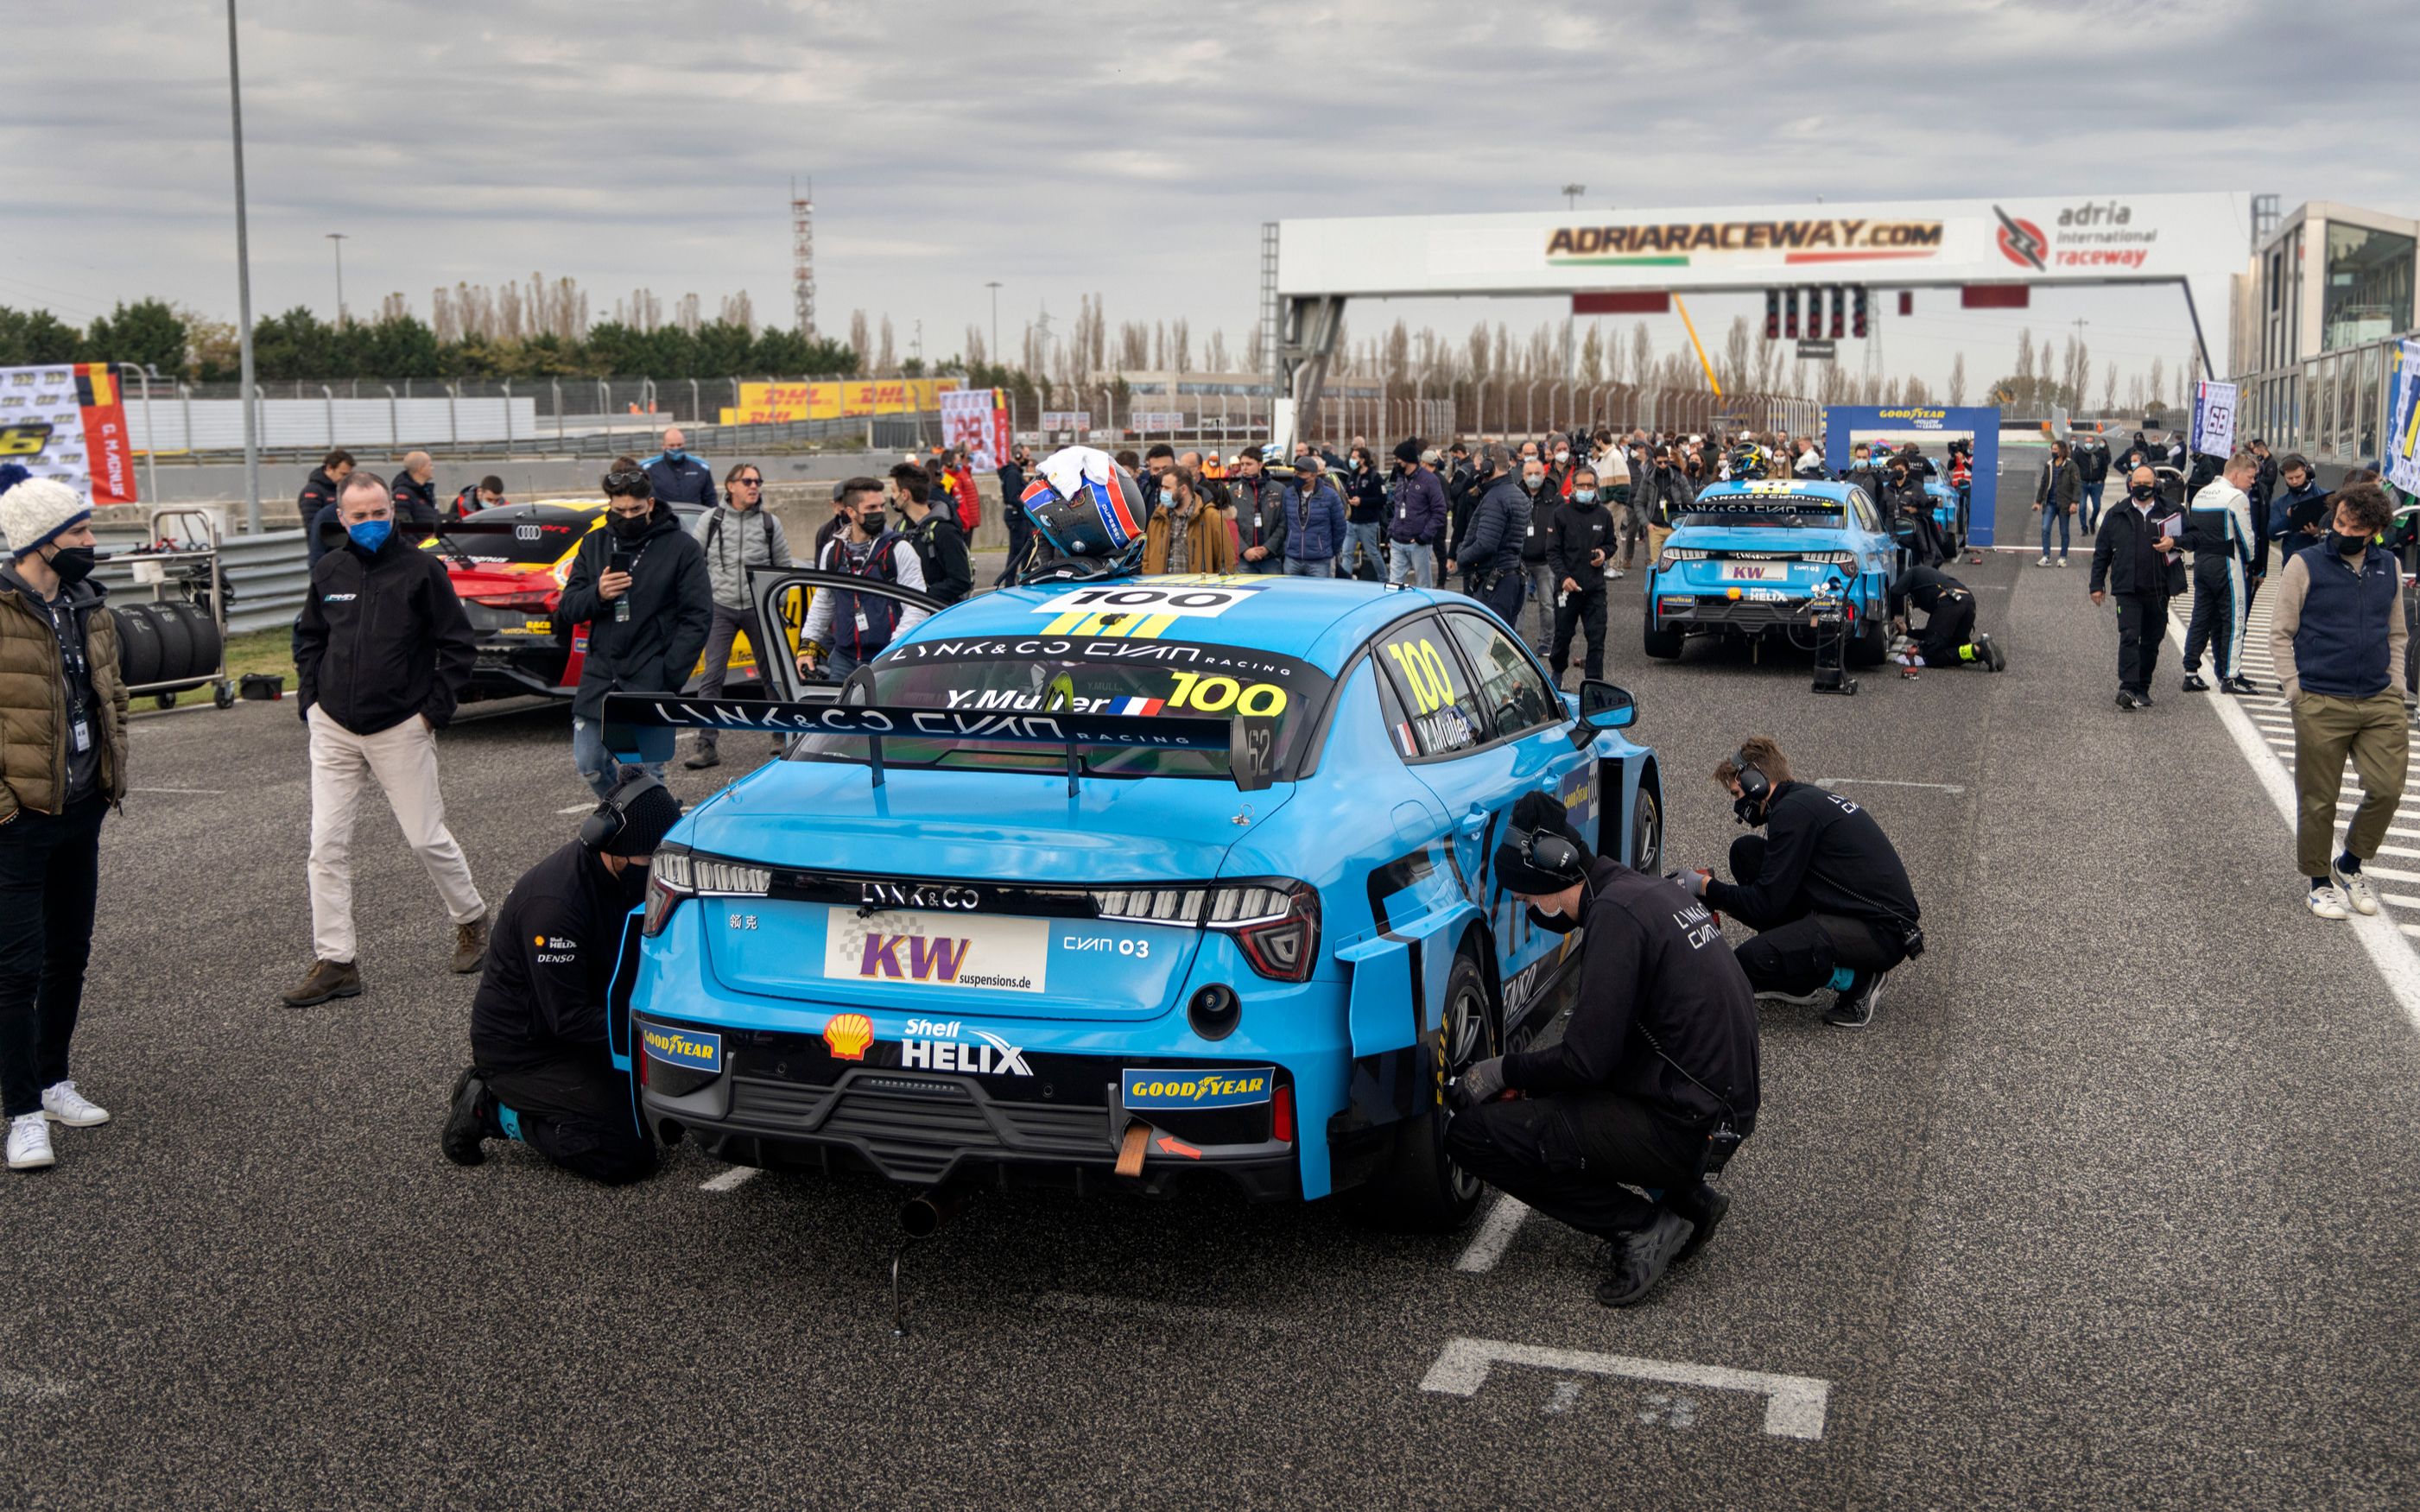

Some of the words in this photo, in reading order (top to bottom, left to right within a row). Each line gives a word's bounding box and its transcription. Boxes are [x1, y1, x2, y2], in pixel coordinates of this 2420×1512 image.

[2057, 201, 2132, 226] adria
[1547, 220, 1942, 256] ADRIARACEWAY.COM
[2056, 229, 2157, 244] international
[2056, 250, 2148, 269] raceway
[763, 388, 821, 405] DHL
[860, 386, 906, 404] DHL
[1879, 408, 1945, 420] GOODYEAR
[105, 440, 125, 497] MAGNUS
[1733, 566, 1765, 579] KW
[1070, 591, 1232, 608] 100
[1750, 590, 1788, 602] HELIX
[890, 641, 1070, 661] LYNK&CO
[1205, 657, 1290, 676] RACING
[1387, 638, 1454, 715] 100
[1166, 672, 1287, 718] 100
[656, 702, 894, 731] LYNK&CO
[1077, 732, 1189, 743] RACING
[1417, 712, 1471, 753] Y.Muller
[862, 883, 979, 909] LYNK&CO
[549, 939, 577, 949] HELIX
[1118, 939, 1150, 958] 03
[537, 954, 575, 963] DENSO
[858, 933, 972, 983] KW
[960, 972, 1031, 990] suspensions.de
[905, 1018, 961, 1037] Shell
[643, 1028, 714, 1060] GOODYEAR
[902, 1031, 1034, 1076] HELIX
[1436, 1012, 1449, 1105] EAGLE
[1132, 1076, 1264, 1101] GOODYEAR
